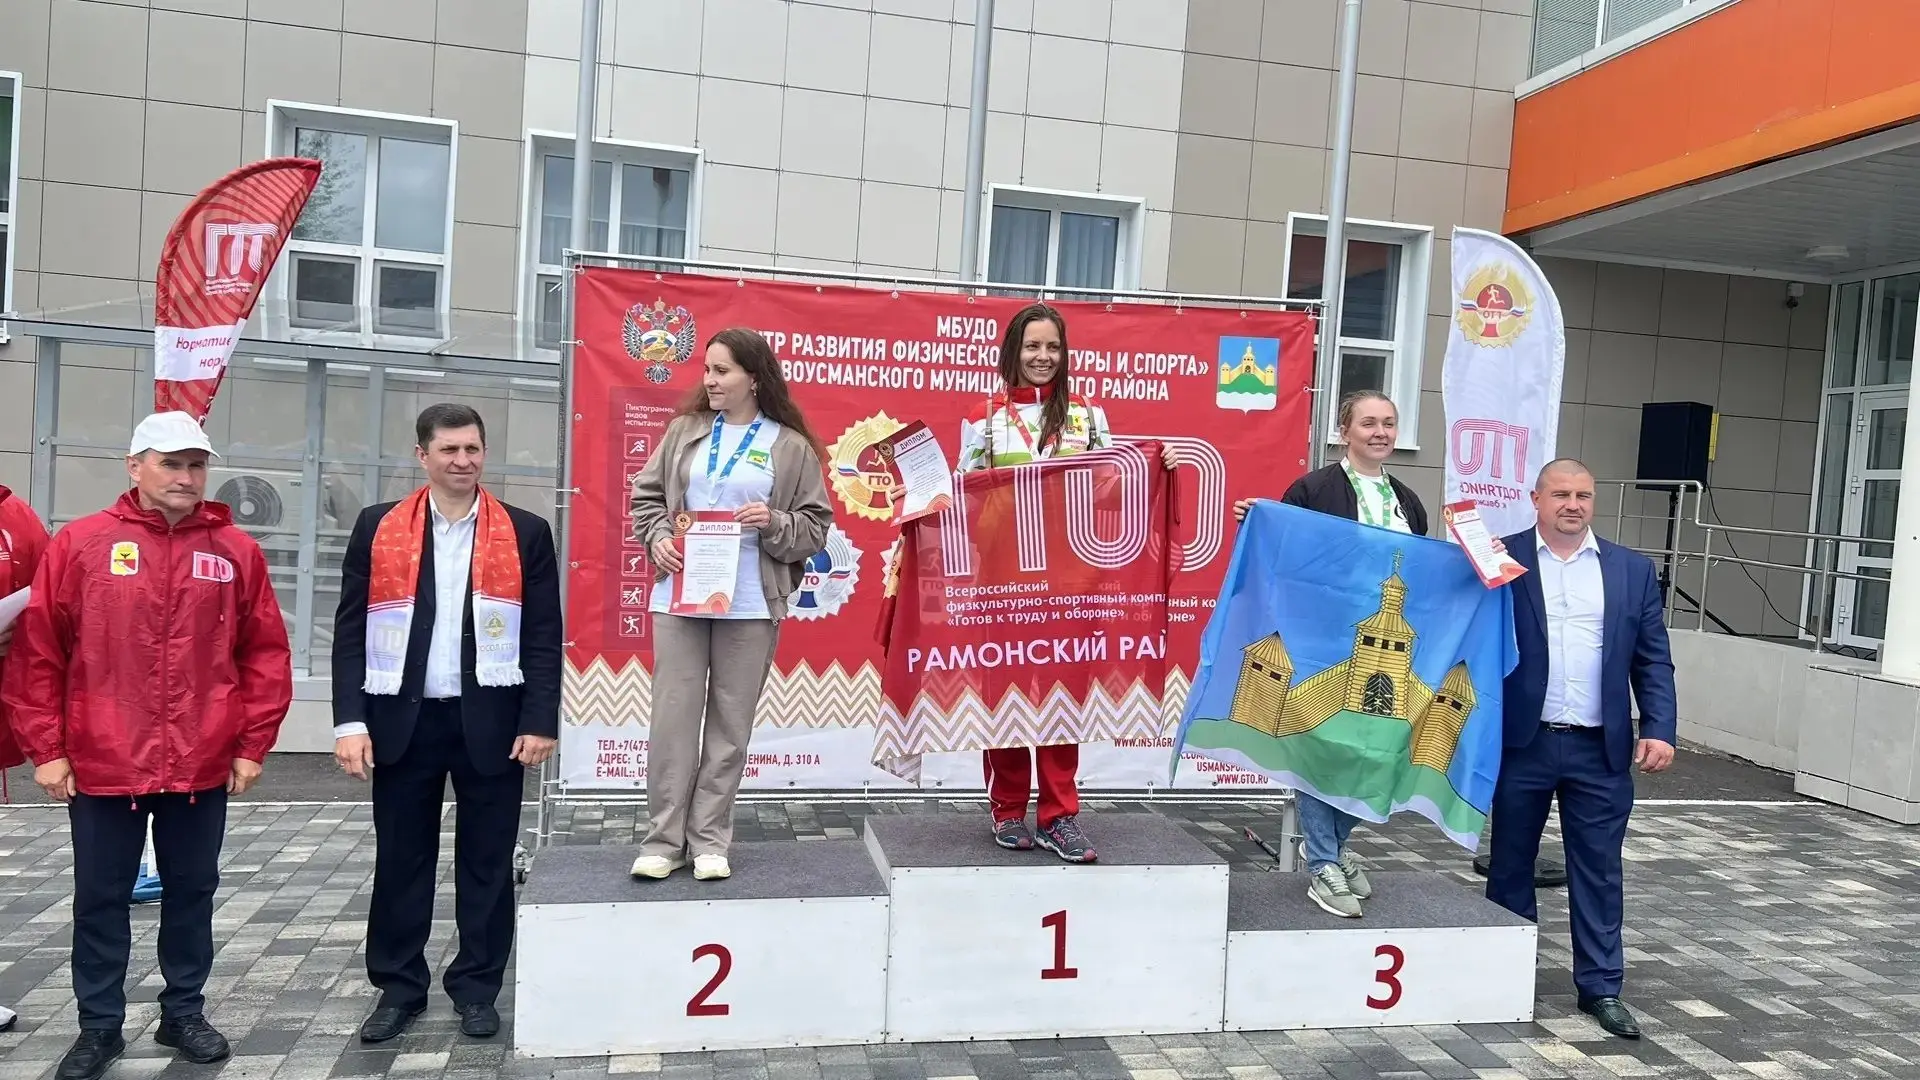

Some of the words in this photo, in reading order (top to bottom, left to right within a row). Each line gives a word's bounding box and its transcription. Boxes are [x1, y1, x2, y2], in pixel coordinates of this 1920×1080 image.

[937, 316, 997, 343] МБУДО
[792, 333, 886, 360] РАЗВИТИЯ
[1117, 353, 1128, 373] И
[1135, 353, 1209, 376] СПОРТА»
[1102, 374, 1169, 401] РАЙОНА
[625, 419, 666, 427] испытаний
[900, 432, 927, 450] ДИПЛОМ
[868, 475, 892, 486] ГТО
[699, 524, 734, 532] ДИПЛОМ
[804, 575, 820, 585] ТО
[945, 580, 1049, 598] Всероссийский
[946, 592, 1127, 614] физкультурно-спортивный
[948, 614, 993, 626] «Готов
[997, 615, 1004, 623] к
[1007, 612, 1047, 624] труду
[1052, 611, 1060, 619] и
[1065, 606, 1125, 620] обороне»
[908, 630, 1106, 672] РАМОНСКИЙ
[596, 753, 631, 766] АДРЕС:
[747, 754, 781, 766] ЕНИНА,
[783, 754, 793, 766] Д.
[796, 754, 812, 765] 310
[813, 754, 820, 765] А
[1040, 910, 1078, 981] 1
[686, 943, 732, 1017] 2
[1366, 944, 1403, 1011] 3
